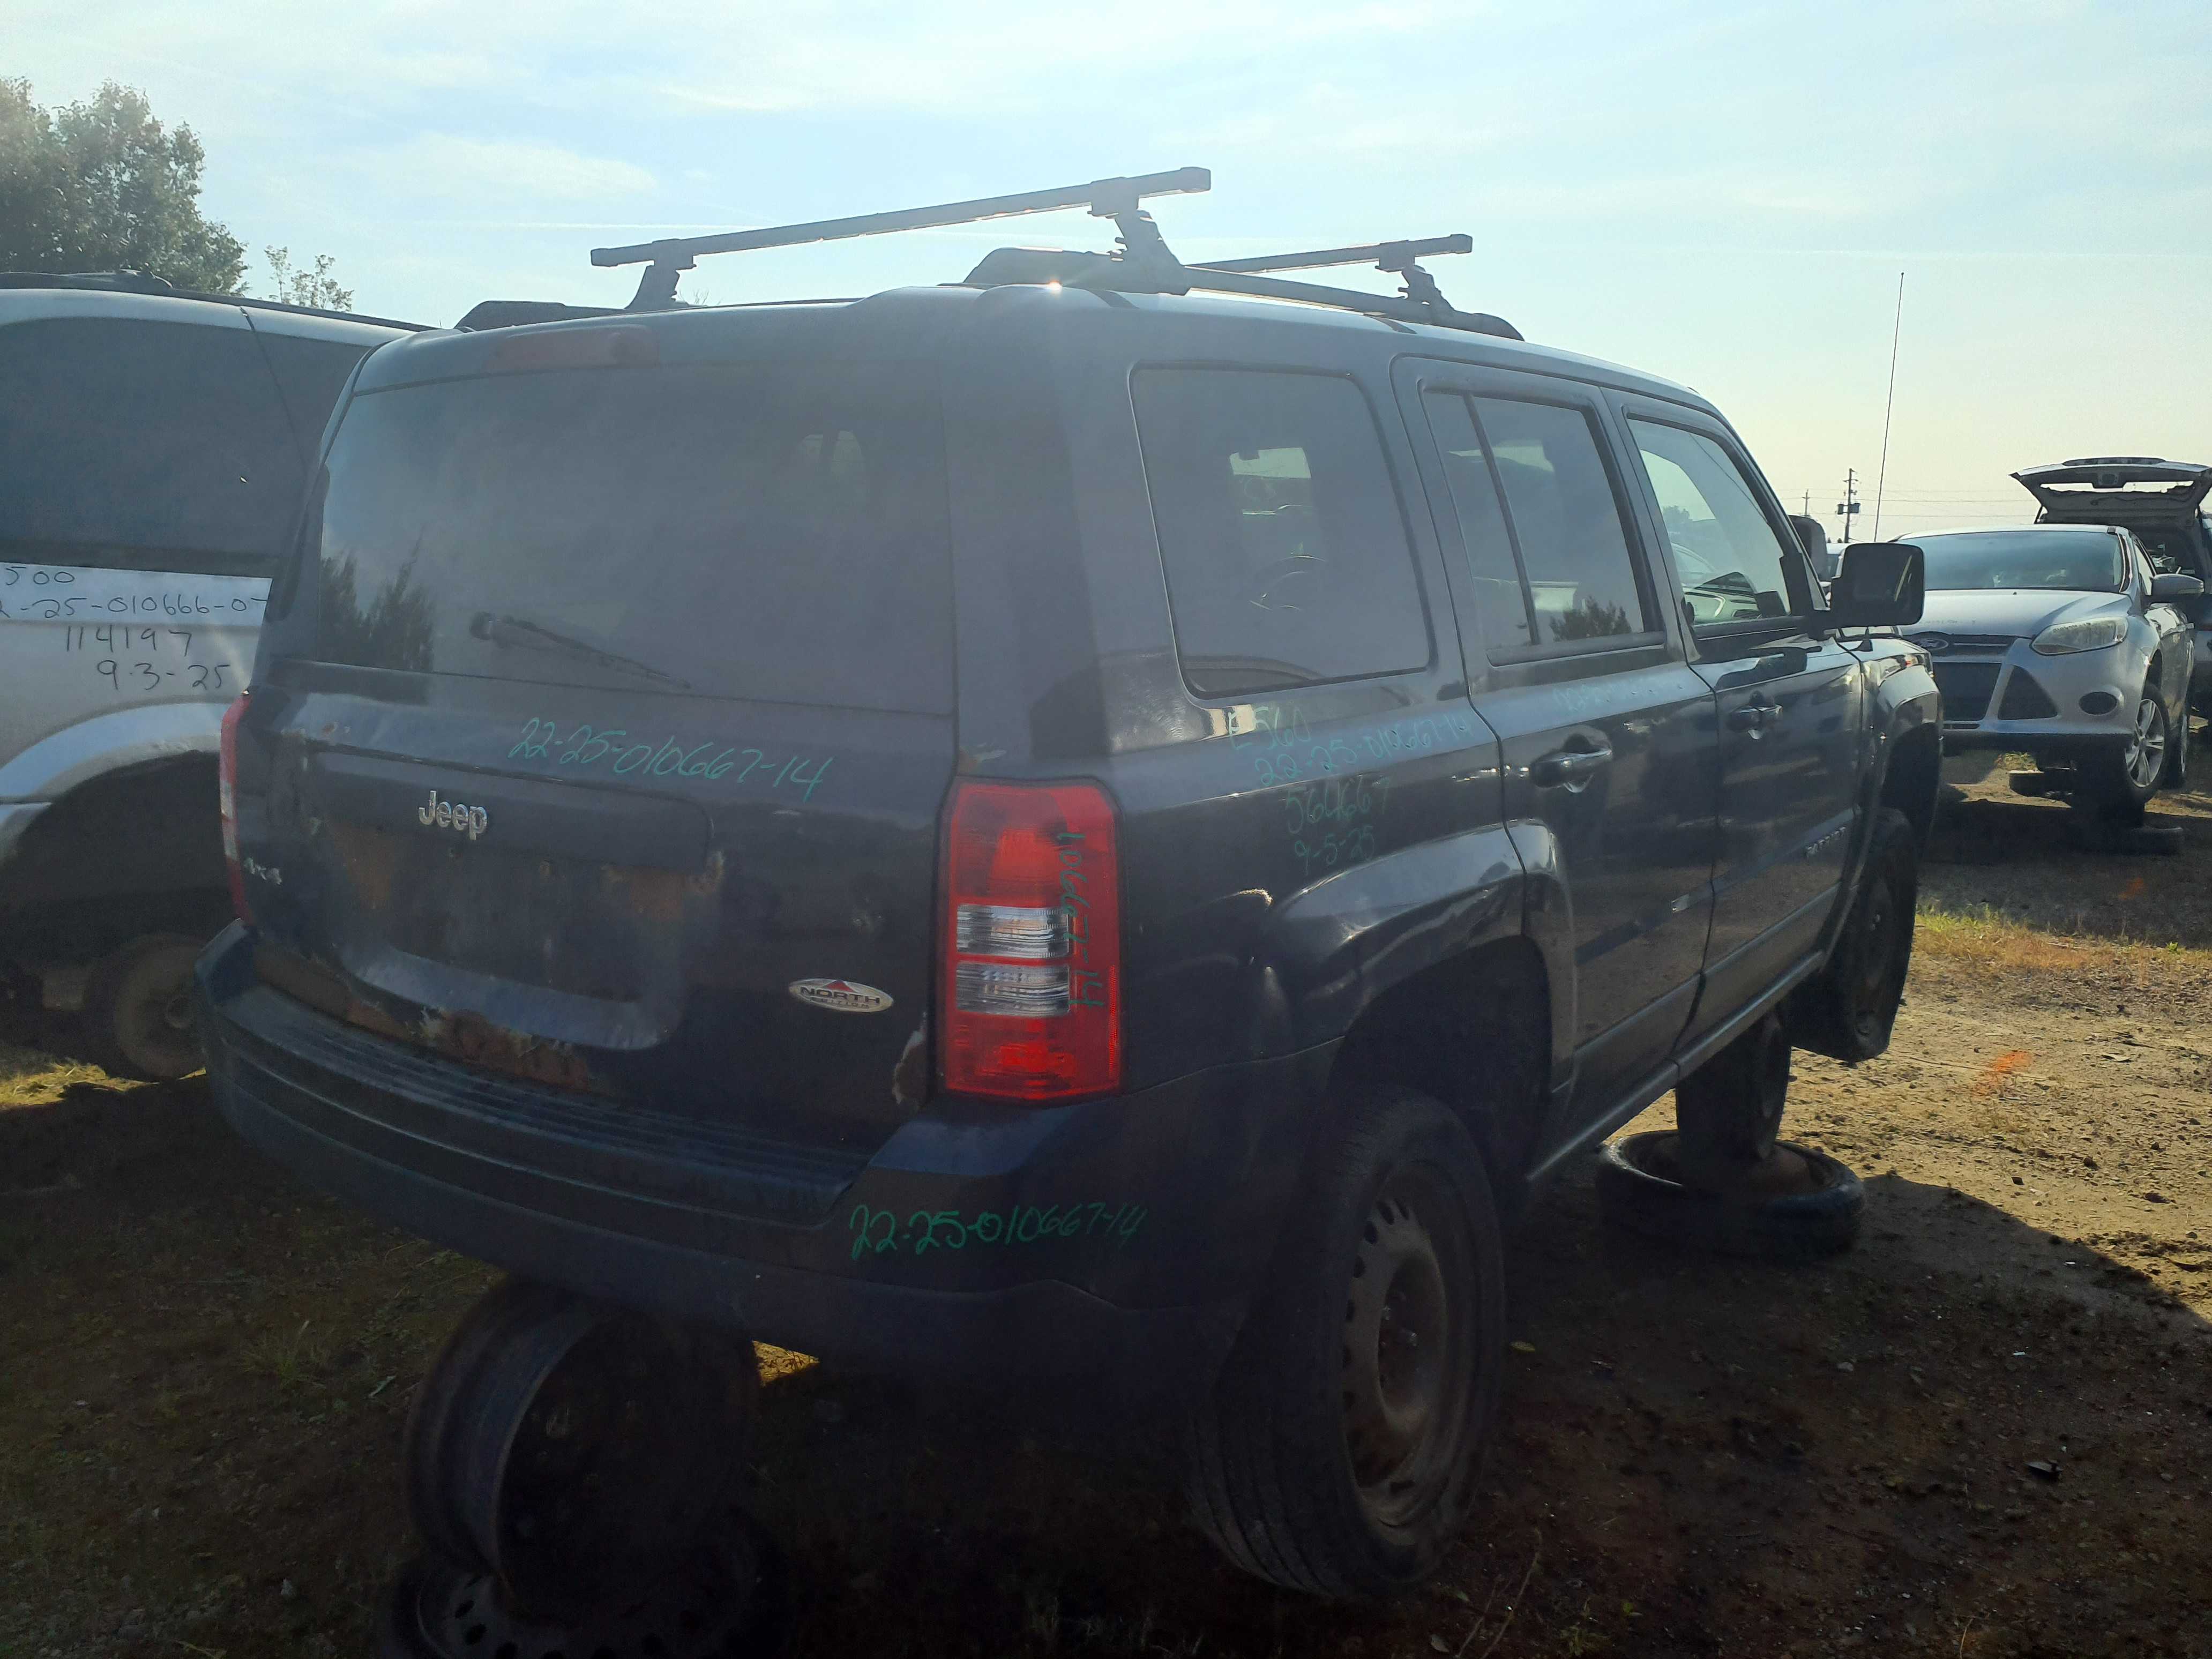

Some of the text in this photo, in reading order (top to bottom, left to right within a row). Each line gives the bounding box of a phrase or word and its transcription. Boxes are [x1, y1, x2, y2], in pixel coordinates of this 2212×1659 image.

[66, 625, 192, 657] 114197
[418, 789, 489, 841] Jeep
[800, 987, 880, 1004] NORTH
